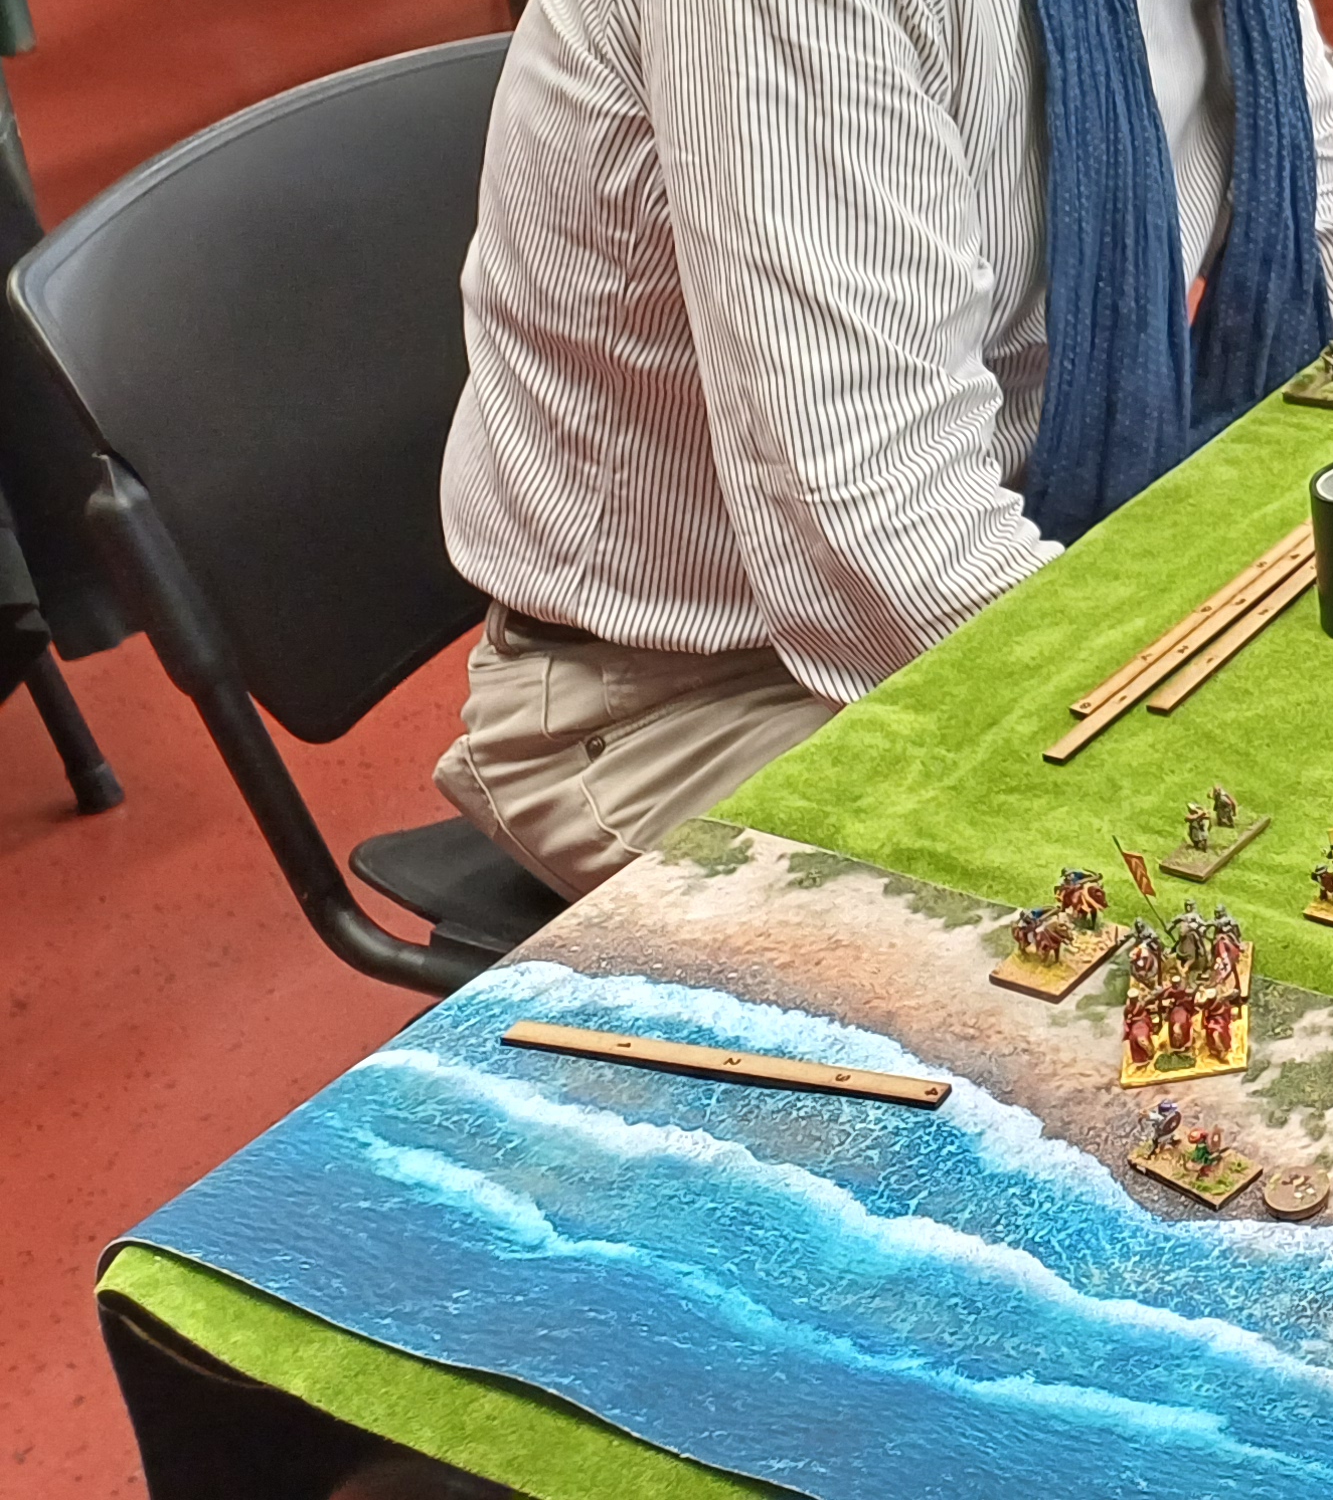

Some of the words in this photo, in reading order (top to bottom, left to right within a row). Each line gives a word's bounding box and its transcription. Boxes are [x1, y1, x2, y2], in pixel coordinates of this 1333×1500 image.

[722, 1057, 742, 1065] 2
[835, 1073, 851, 1082] 3
[924, 1086, 939, 1096] 4
